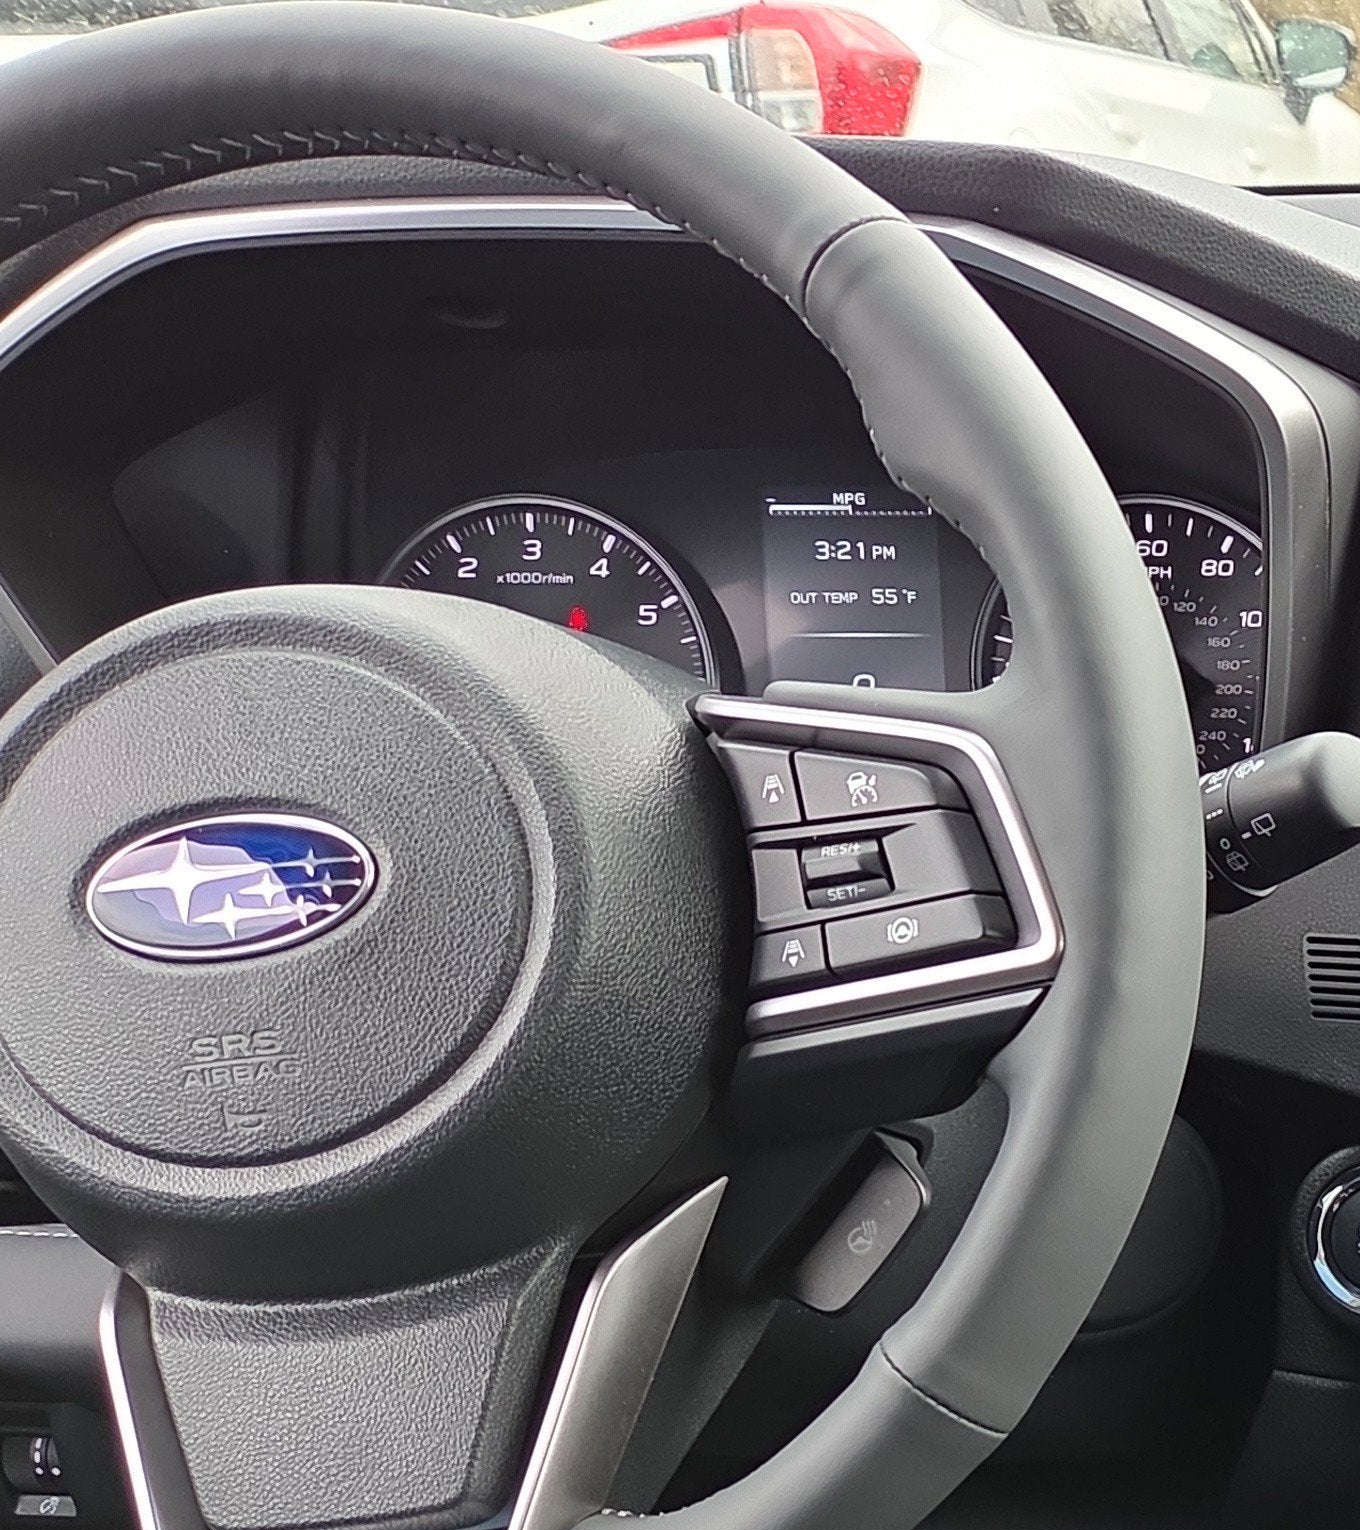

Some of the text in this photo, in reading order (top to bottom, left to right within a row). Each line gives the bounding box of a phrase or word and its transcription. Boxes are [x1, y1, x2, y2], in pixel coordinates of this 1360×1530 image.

[833, 492, 866, 505] MPG
[522, 540, 542, 560] 3
[814, 540, 896, 560] 3:21 PM
[1136, 540, 1168, 557] 60
[457, 558, 478, 578] 2
[589, 558, 610, 578] 4
[1201, 559, 1234, 577] 80
[790, 592, 818, 604] OUT
[823, 592, 858, 604] TEMP
[871, 588, 898, 604] 55
[638, 604, 657, 625] 5
[1173, 601, 1196, 613] 120
[1194, 615, 1218, 627] 140
[1239, 610, 1262, 628] 10
[1207, 637, 1231, 648] 160
[1217, 660, 1240, 671] 180
[1215, 684, 1243, 695] 200
[1210, 708, 1237, 719] 220
[1199, 730, 1227, 740] 240
[191, 1030, 283, 1062] SRS
[183, 1061, 303, 1088] AIRBAG
